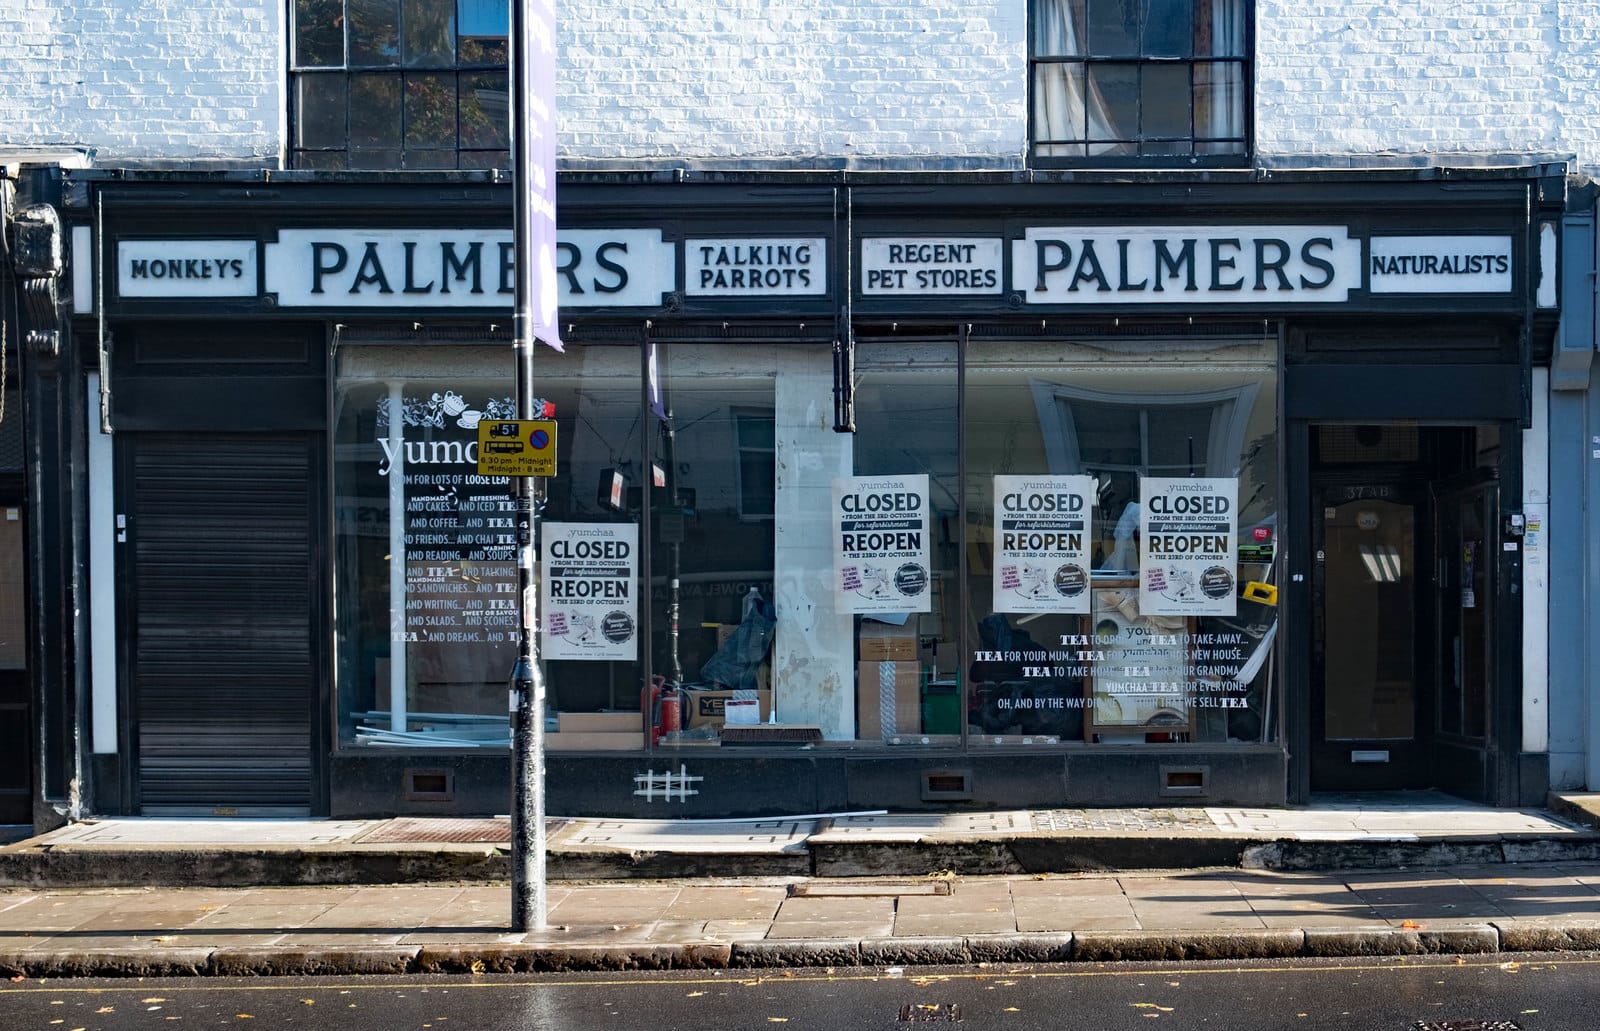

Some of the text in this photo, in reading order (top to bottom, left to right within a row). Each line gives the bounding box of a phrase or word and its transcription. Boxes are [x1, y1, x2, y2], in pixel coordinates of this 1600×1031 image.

[700, 246, 811, 266] TALKING
[889, 244, 976, 263] REGENT
[130, 259, 243, 279] MONKEYS
[1034, 238, 1335, 292] PALMERS
[1372, 255, 1508, 275] NATURALISTS
[700, 269, 811, 288] PARROTS
[867, 269, 997, 289] PET STORES
[377, 437, 478, 476] yumc
[518, 457, 552, 465] Midnight
[488, 466, 521, 474] Midnight
[414, 475, 431, 485] FOR
[431, 475, 451, 485] LOTS
[452, 475, 463, 485] OF
[465, 475, 491, 485] LOOSE
[858, 481, 904, 491] yumchaa
[1020, 481, 1067, 491] yumchaa
[1166, 483, 1214, 493] yumchaa
[407, 502, 425, 511] AND
[459, 502, 475, 511] AND
[477, 502, 495, 511] ICED
[497, 501, 517, 511] TE
[841, 493, 921, 512] CLOSED
[1002, 493, 1084, 512] CLOSED
[1148, 496, 1230, 514] CLOSED
[410, 518, 427, 528] AND
[466, 518, 483, 528] AND
[567, 528, 615, 538] yumchaa
[456, 534, 474, 544] AND
[475, 534, 494, 544] CHAI
[496, 534, 517, 544] TE
[842, 533, 921, 551] REOPEN
[1003, 533, 1082, 550] REOPEN
[1149, 536, 1228, 553] REOPEN
[407, 550, 425, 560] AND
[468, 550, 486, 560] AND
[550, 541, 630, 559] CLOSED
[406, 567, 423, 576] AND
[462, 567, 479, 576] AND
[476, 583, 493, 592] AND
[550, 580, 629, 597] REOPEN
[406, 600, 423, 609] AND
[466, 600, 483, 609] AND
[407, 616, 424, 625] AND
[465, 616, 482, 625] AND
[428, 632, 446, 642] AND
[487, 632, 504, 642] AND
[1125, 627, 1152, 639] you
[1060, 634, 1088, 645] TEA
[1149, 634, 1177, 645] TEA
[974, 650, 1002, 661] TEA
[1004, 651, 1021, 661] FOR
[1022, 651, 1048, 661] YOUR
[1076, 650, 1105, 661] TEA
[1191, 650, 1210, 660] NEW
[1022, 666, 1051, 677] TEA
[1053, 667, 1065, 677] TO
[1067, 667, 1088, 677] TAKE
[1123, 666, 1151, 677] TEA
[1106, 682, 1148, 693] YUMCHAA
[1152, 682, 1178, 693] TEA
[1199, 681, 1248, 692] EVERYONE!
[1014, 698, 1033, 709] AND
[1034, 698, 1046, 709] BY
[1048, 698, 1064, 709] THE
[1066, 698, 1085, 709] WAY
[1184, 697, 1198, 708] WE
[1200, 697, 1219, 708] SELL
[1220, 697, 1249, 708] TEA
